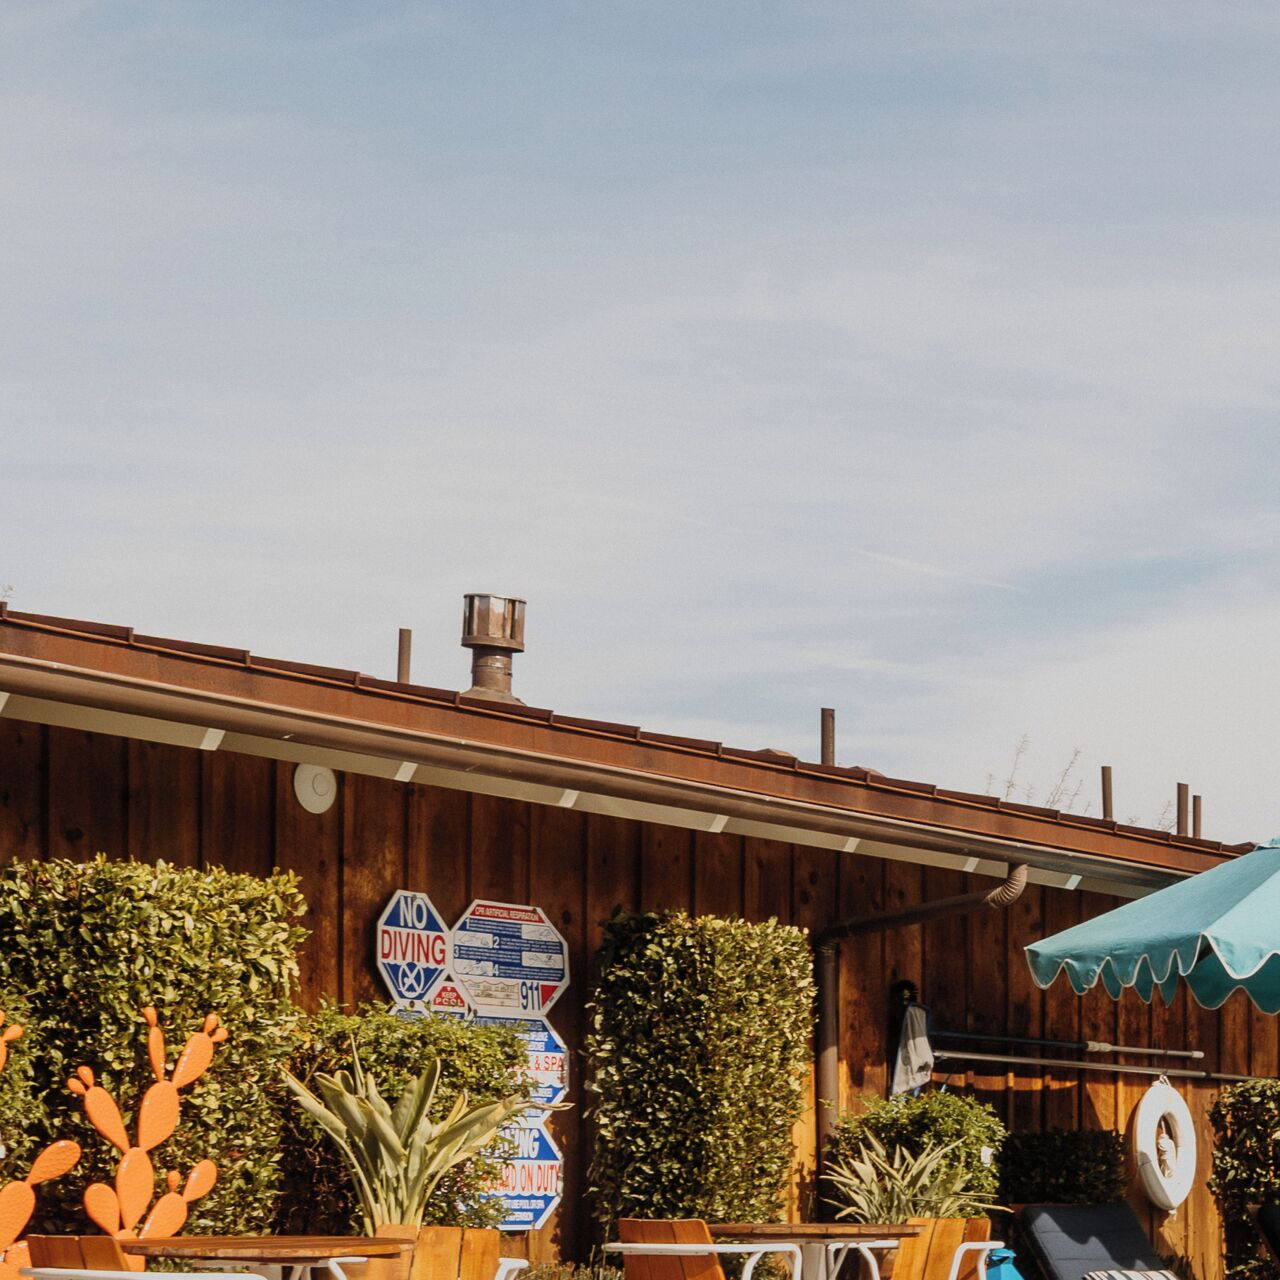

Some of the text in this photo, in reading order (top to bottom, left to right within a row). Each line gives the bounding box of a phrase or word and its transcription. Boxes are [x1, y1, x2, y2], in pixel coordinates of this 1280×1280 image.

[399, 895, 428, 930] NO
[381, 929, 446, 965] DIVING
[493, 936, 500, 948] 2
[453, 946, 460, 957] 3
[493, 964, 499, 976] 4
[435, 998, 464, 1006] POOL
[520, 981, 541, 1010] 911
[543, 1055, 564, 1071] SPA
[520, 1163, 534, 1192] ON
[536, 1163, 560, 1193] DUTY
